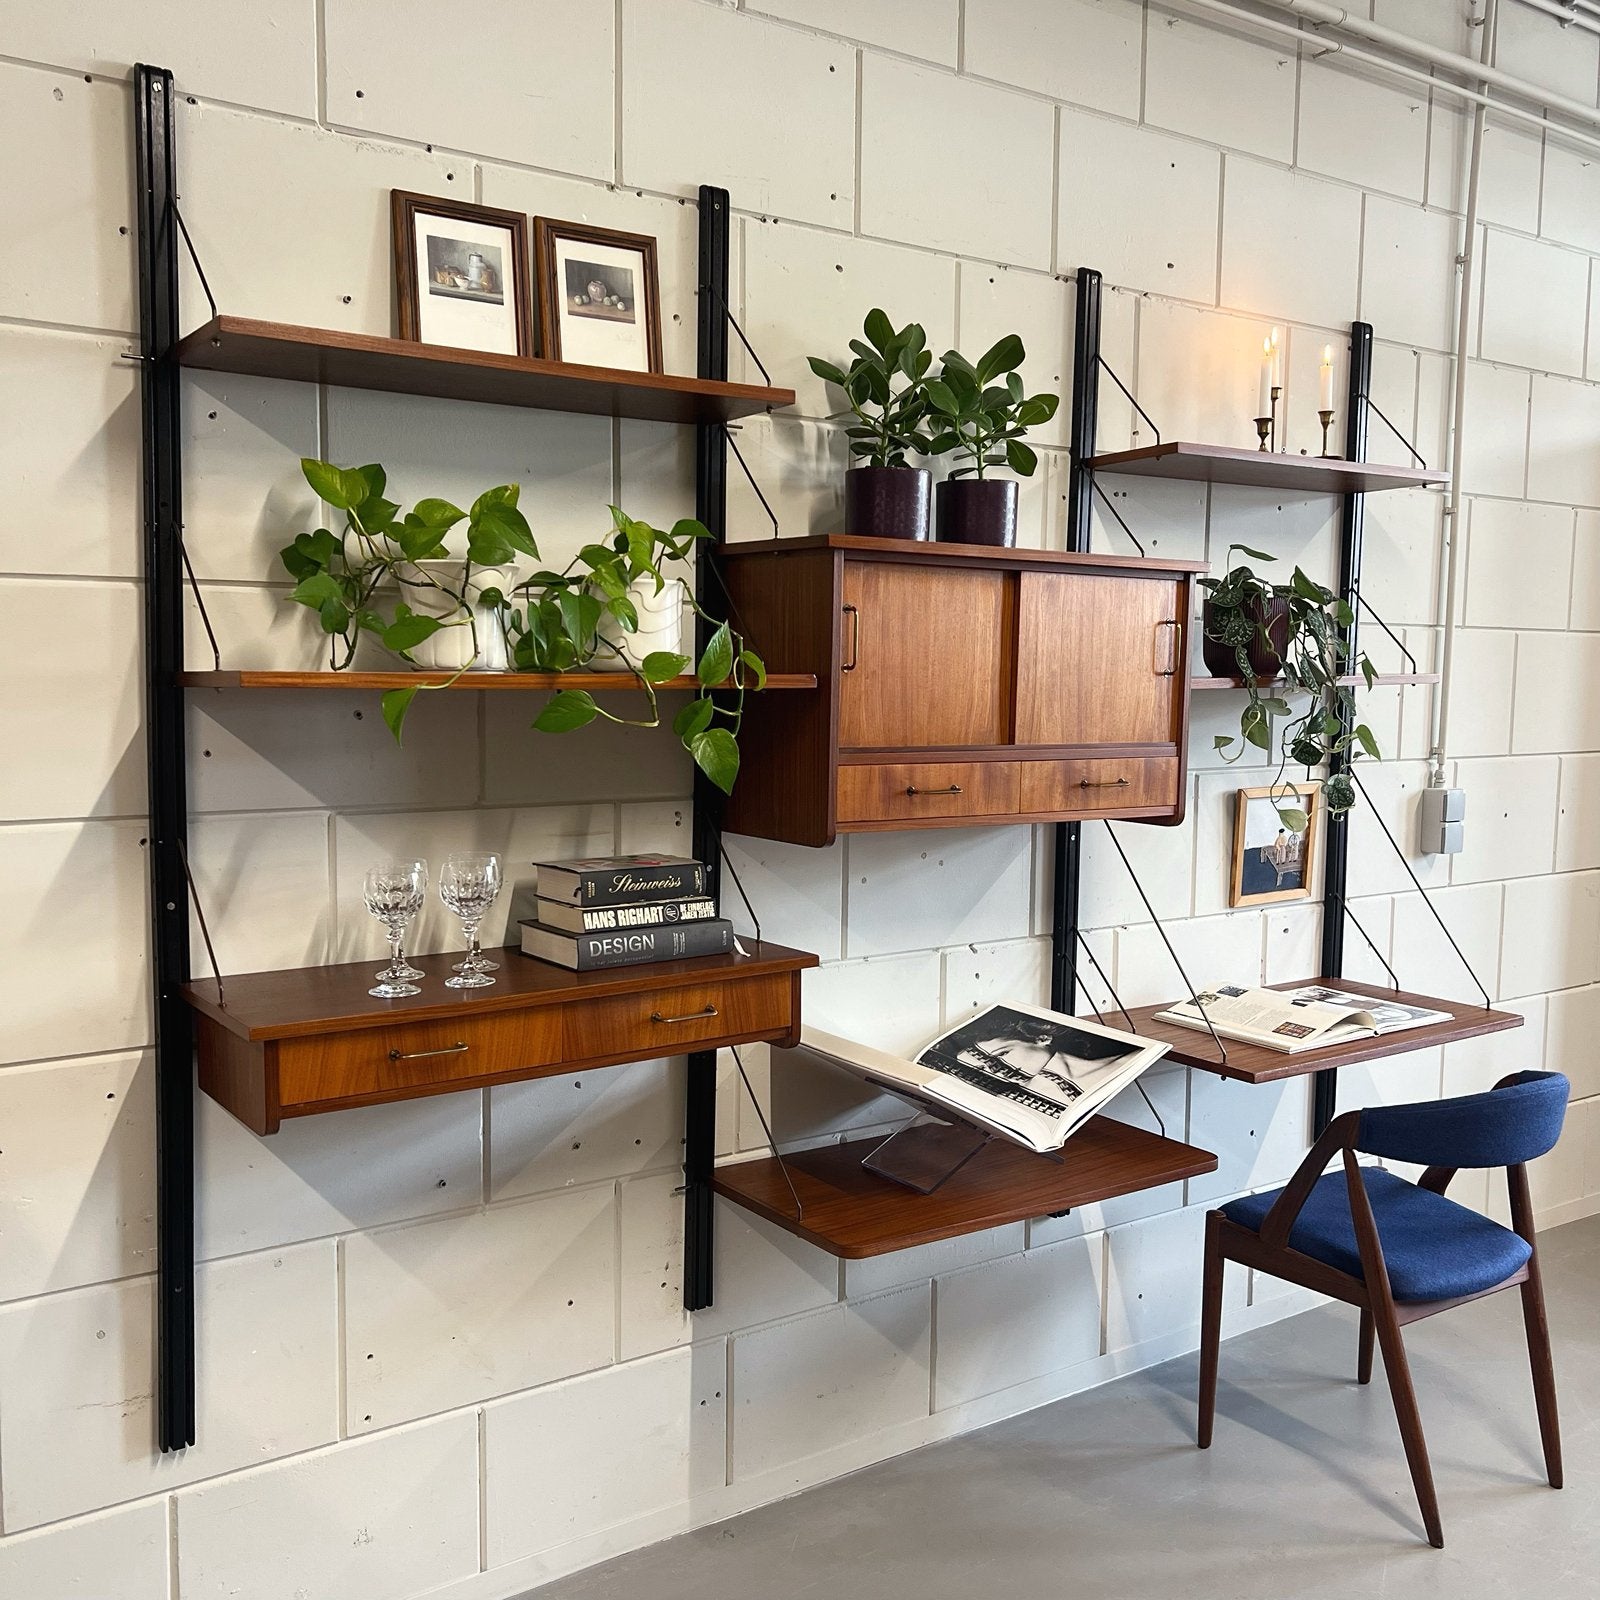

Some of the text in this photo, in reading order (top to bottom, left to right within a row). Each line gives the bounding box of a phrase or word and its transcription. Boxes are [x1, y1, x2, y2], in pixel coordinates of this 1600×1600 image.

[608, 873, 682, 893] Steinweiss
[583, 905, 664, 930] HANS RIGHART
[589, 933, 655, 957] DESIGN
